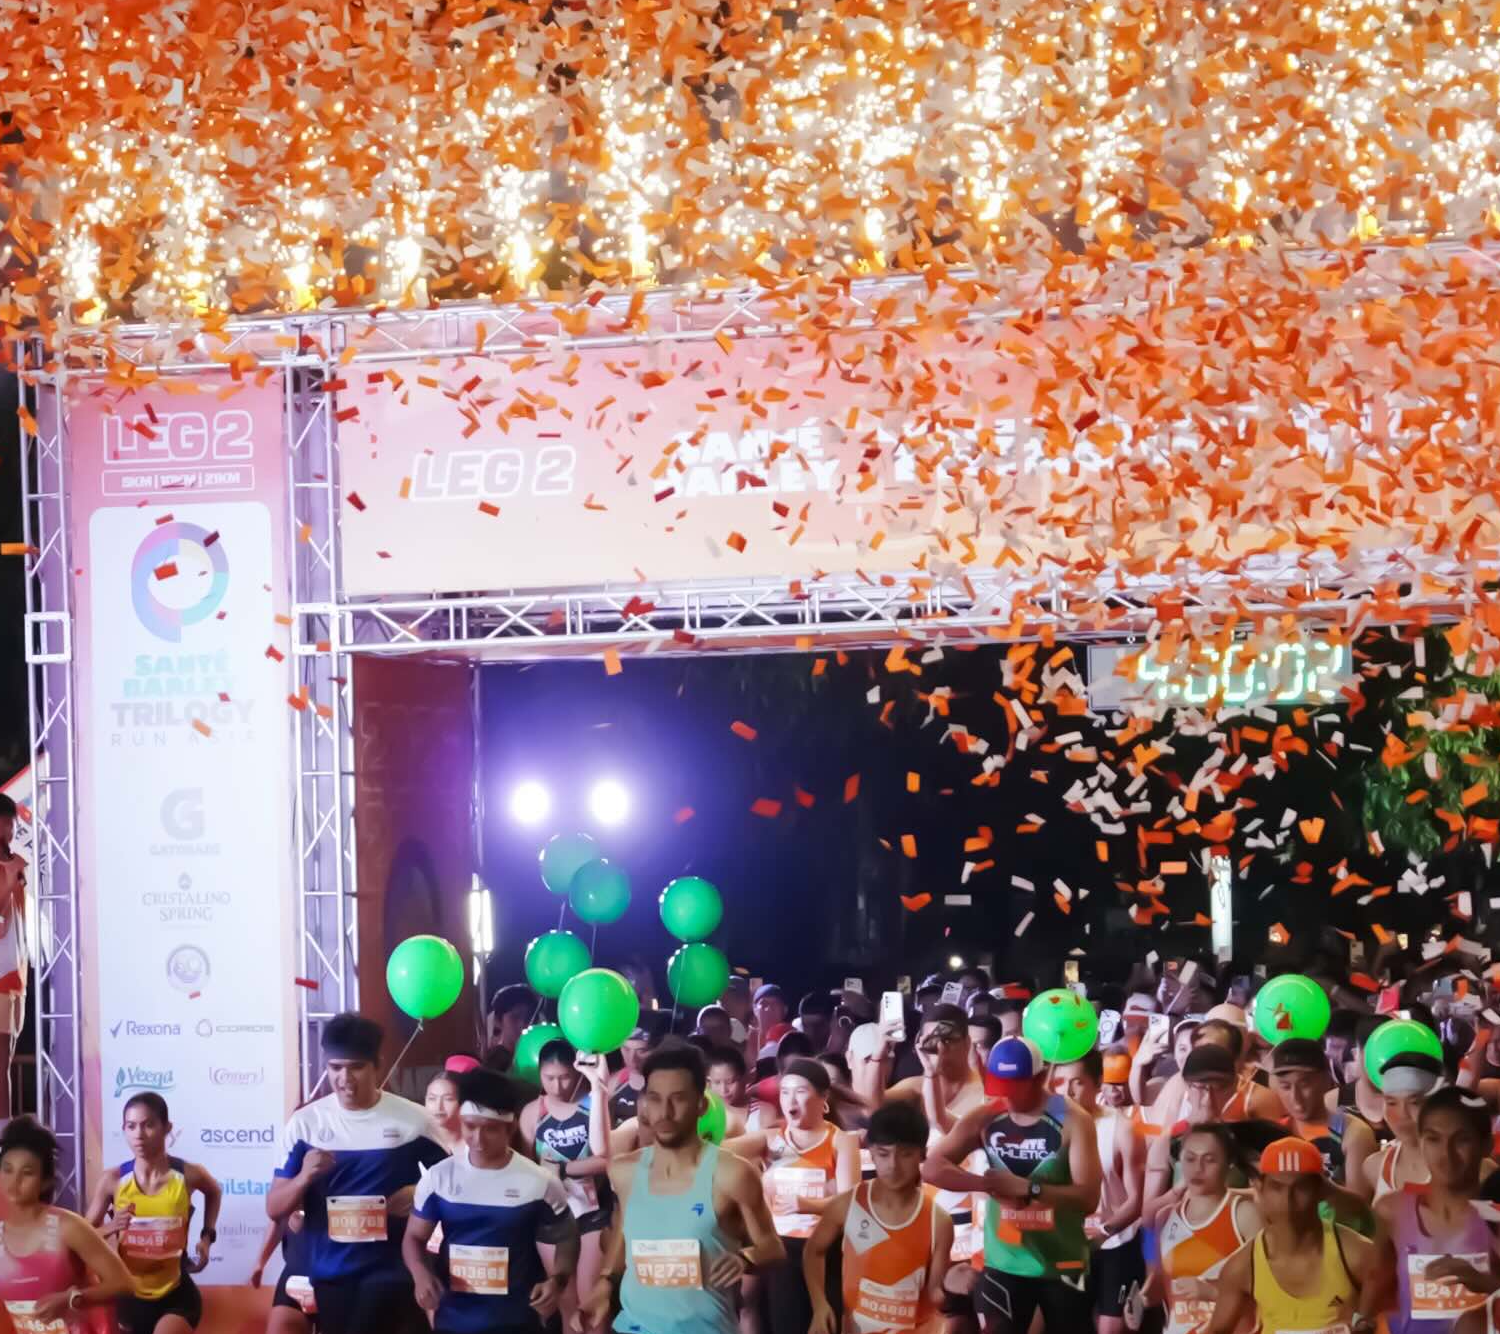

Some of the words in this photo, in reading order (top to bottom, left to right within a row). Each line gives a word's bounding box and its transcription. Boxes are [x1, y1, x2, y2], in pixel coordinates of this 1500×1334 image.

[103, 411, 208, 464] LEG
[213, 410, 254, 460] 2
[410, 447, 524, 502] LEG
[531, 444, 576, 496] 2
[110, 699, 257, 728] TRILOGY
[126, 1020, 181, 1036] Rexona
[200, 1124, 274, 1144] ascend
